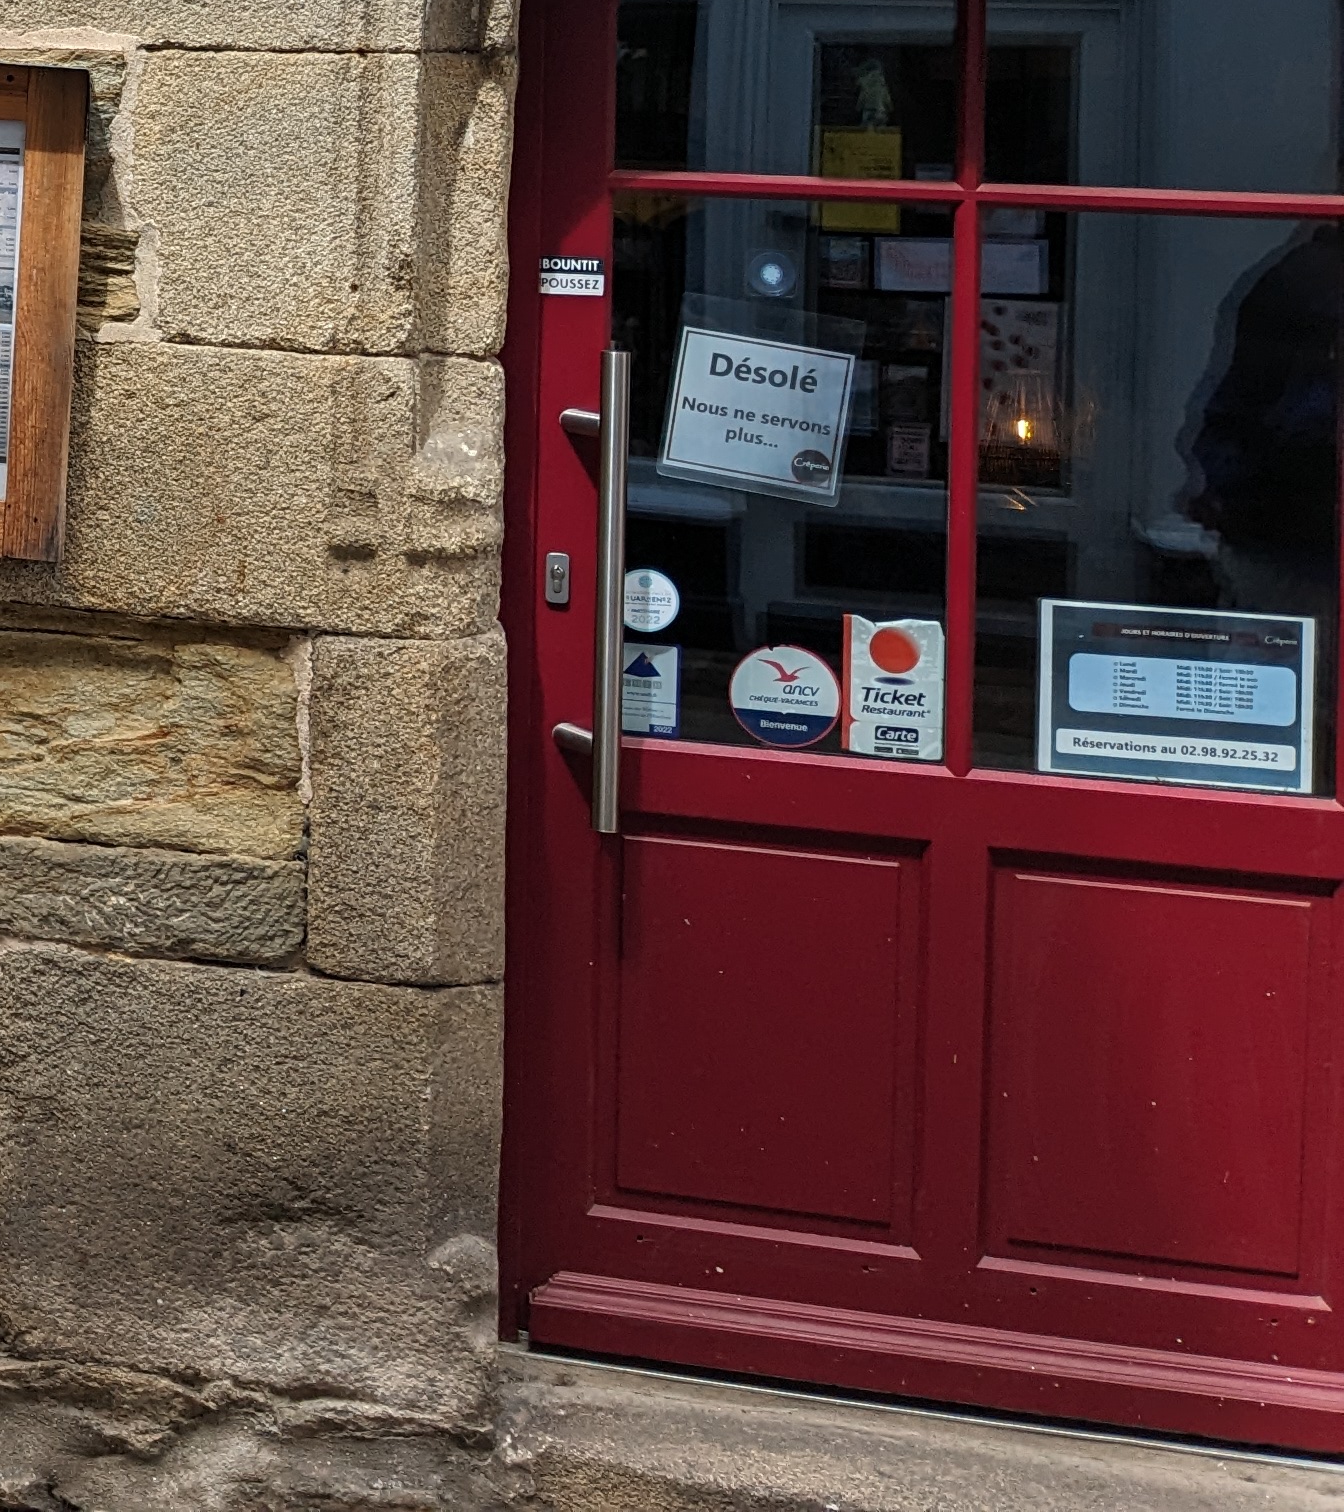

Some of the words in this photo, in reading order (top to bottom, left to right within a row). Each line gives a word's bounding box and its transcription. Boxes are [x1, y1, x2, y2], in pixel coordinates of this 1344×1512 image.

[542, 258, 599, 272] BOUNTIT
[541, 277, 600, 290] POUSSEZ
[709, 351, 818, 394] Désolé
[681, 395, 729, 417] Nous
[733, 407, 756, 422] ne
[760, 413, 832, 436] servons
[724, 426, 779, 449] plus...
[631, 615, 661, 625] 2022
[782, 684, 820, 698] ancv
[861, 686, 927, 707] Ticket
[653, 726, 673, 734] 2022
[759, 719, 809, 732] Bienvenue
[876, 727, 917, 742] Carte
[1072, 736, 1157, 755] Réservations
[1160, 745, 1177, 755] au
[1180, 744, 1279, 763] 02.98.92.25.32
